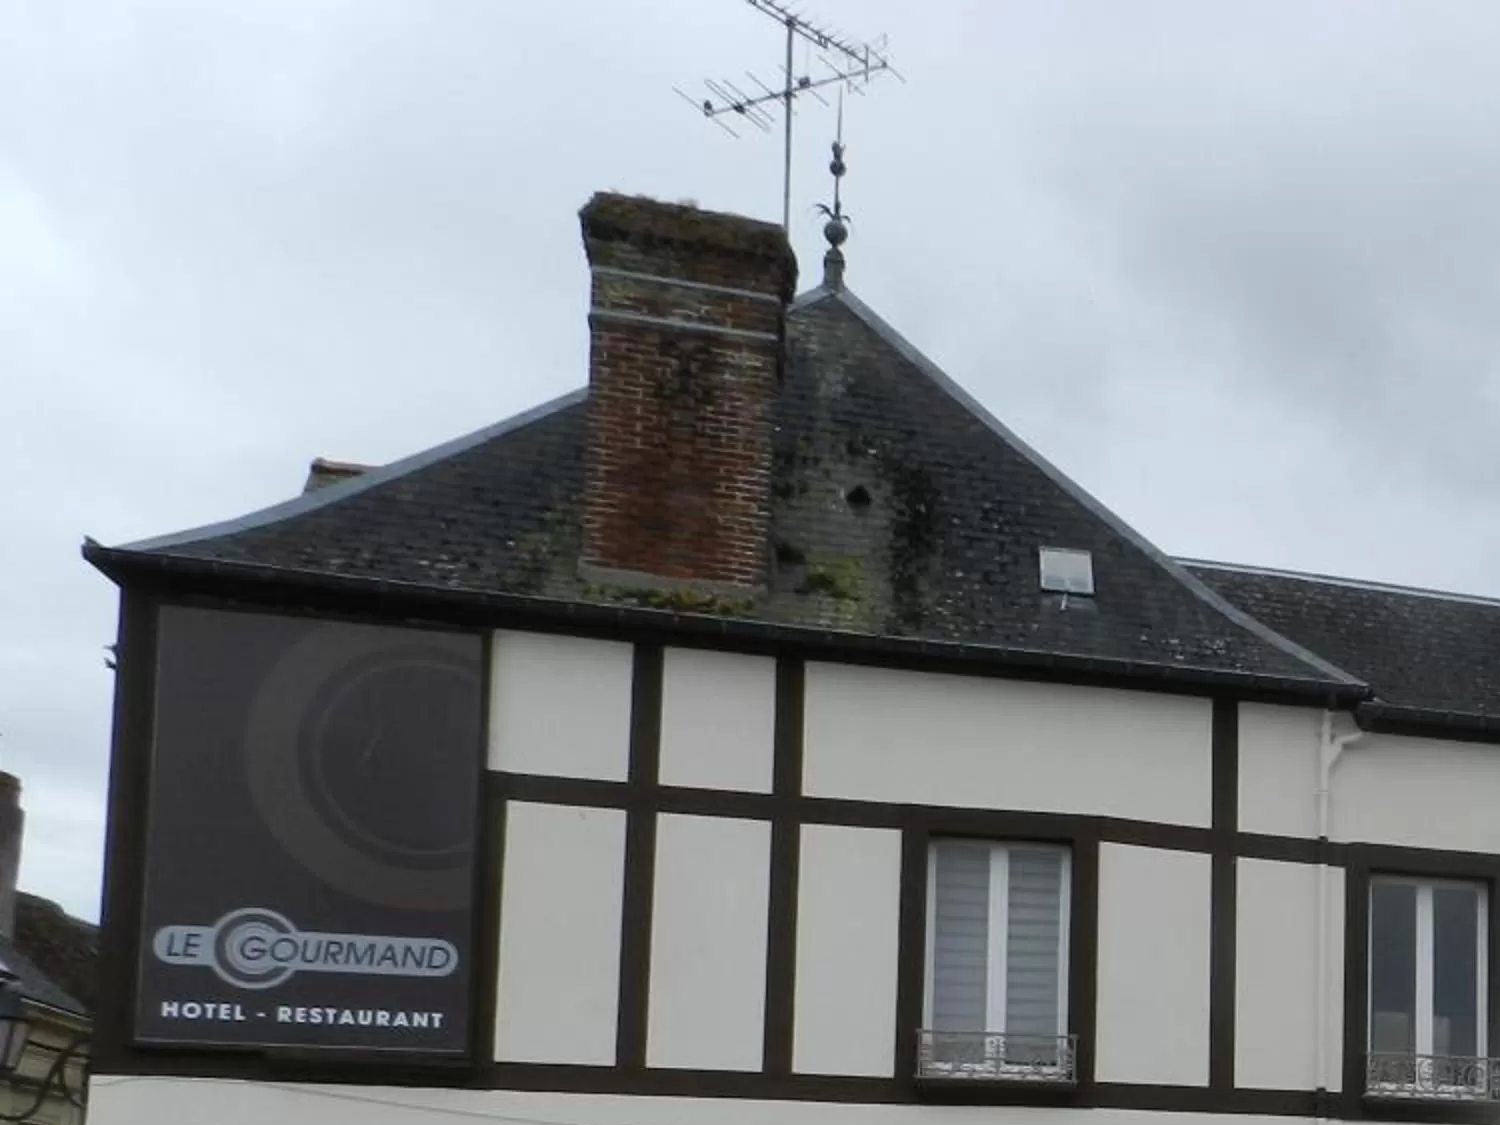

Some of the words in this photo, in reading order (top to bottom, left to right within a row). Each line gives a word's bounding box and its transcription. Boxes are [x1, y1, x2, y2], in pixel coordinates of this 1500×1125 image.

[166, 932, 201, 958] LE
[239, 935, 451, 970] GOURMAND
[161, 1001, 246, 1021] HOTEL
[277, 1006, 444, 1029] RESTAURANT
